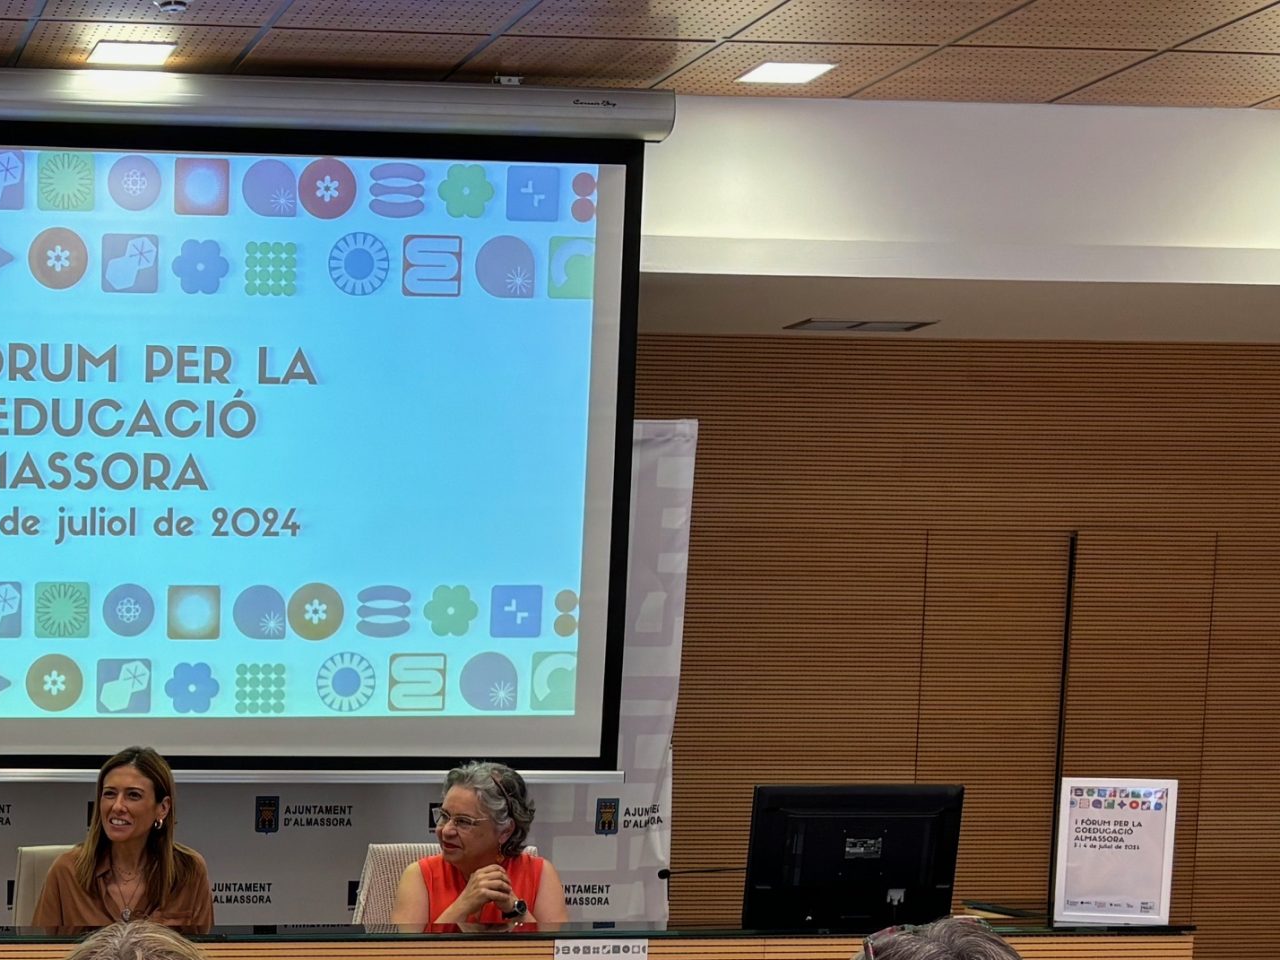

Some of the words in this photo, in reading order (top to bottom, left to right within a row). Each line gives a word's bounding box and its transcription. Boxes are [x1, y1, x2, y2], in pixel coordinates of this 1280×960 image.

[144, 344, 234, 386] PER
[257, 346, 318, 386] LA
[0, 506, 41, 537] de
[54, 506, 136, 545] juliol
[153, 507, 195, 537] de
[210, 507, 302, 538] 2024
[284, 805, 353, 815] AJUNTAMENT
[283, 817, 352, 827] D'ALMASSORA
[1113, 819, 1130, 827] PER
[1132, 820, 1143, 828] LA
[1074, 826, 1134, 835] COEDUCACIÓ
[1073, 834, 1125, 843] ALMASSORA
[211, 882, 272, 893] JUNTAMENT
[563, 884, 611, 894] NTAMENT
[213, 894, 272, 904] ALMASSORA
[565, 896, 610, 906] MASSORA
